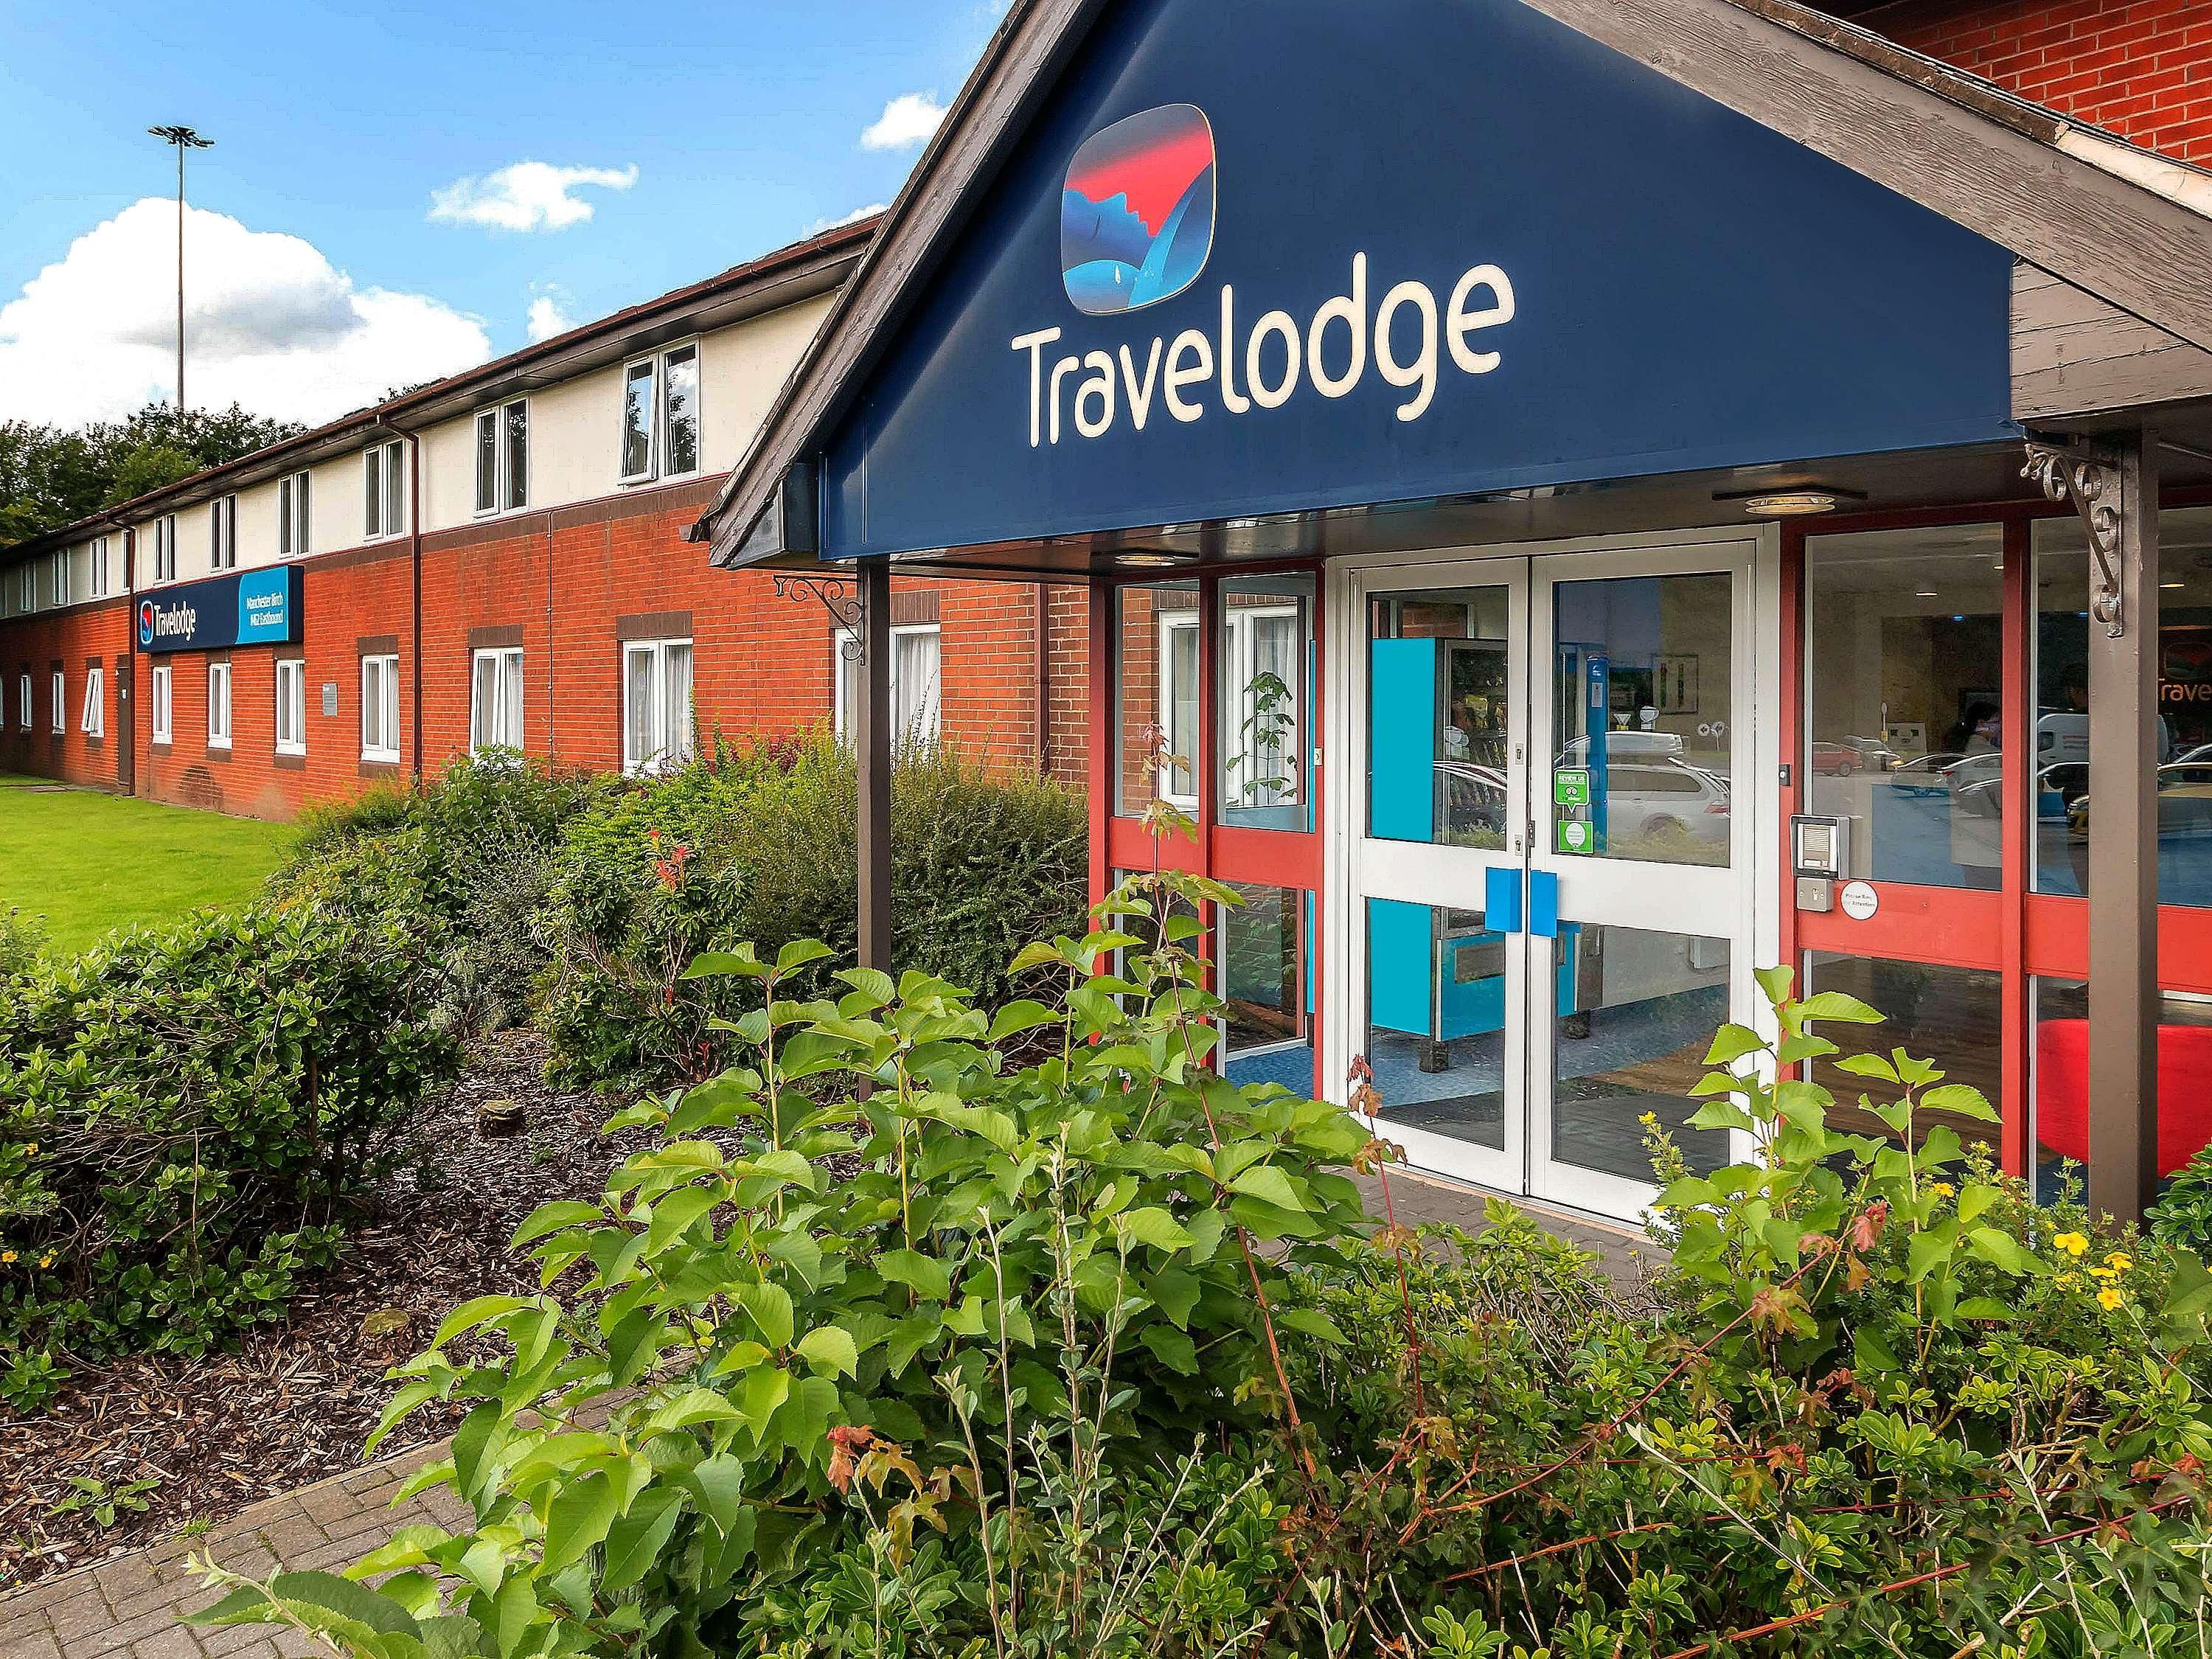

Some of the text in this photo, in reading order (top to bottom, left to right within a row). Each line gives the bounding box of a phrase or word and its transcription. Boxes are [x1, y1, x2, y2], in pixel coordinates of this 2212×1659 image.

[1011, 251, 1515, 448] Travelodge
[246, 591, 283, 610] Manchester Birch
[153, 600, 196, 641] Travelodge
[260, 609, 283, 625] Eastbound
[2158, 678, 2212, 701] rave
